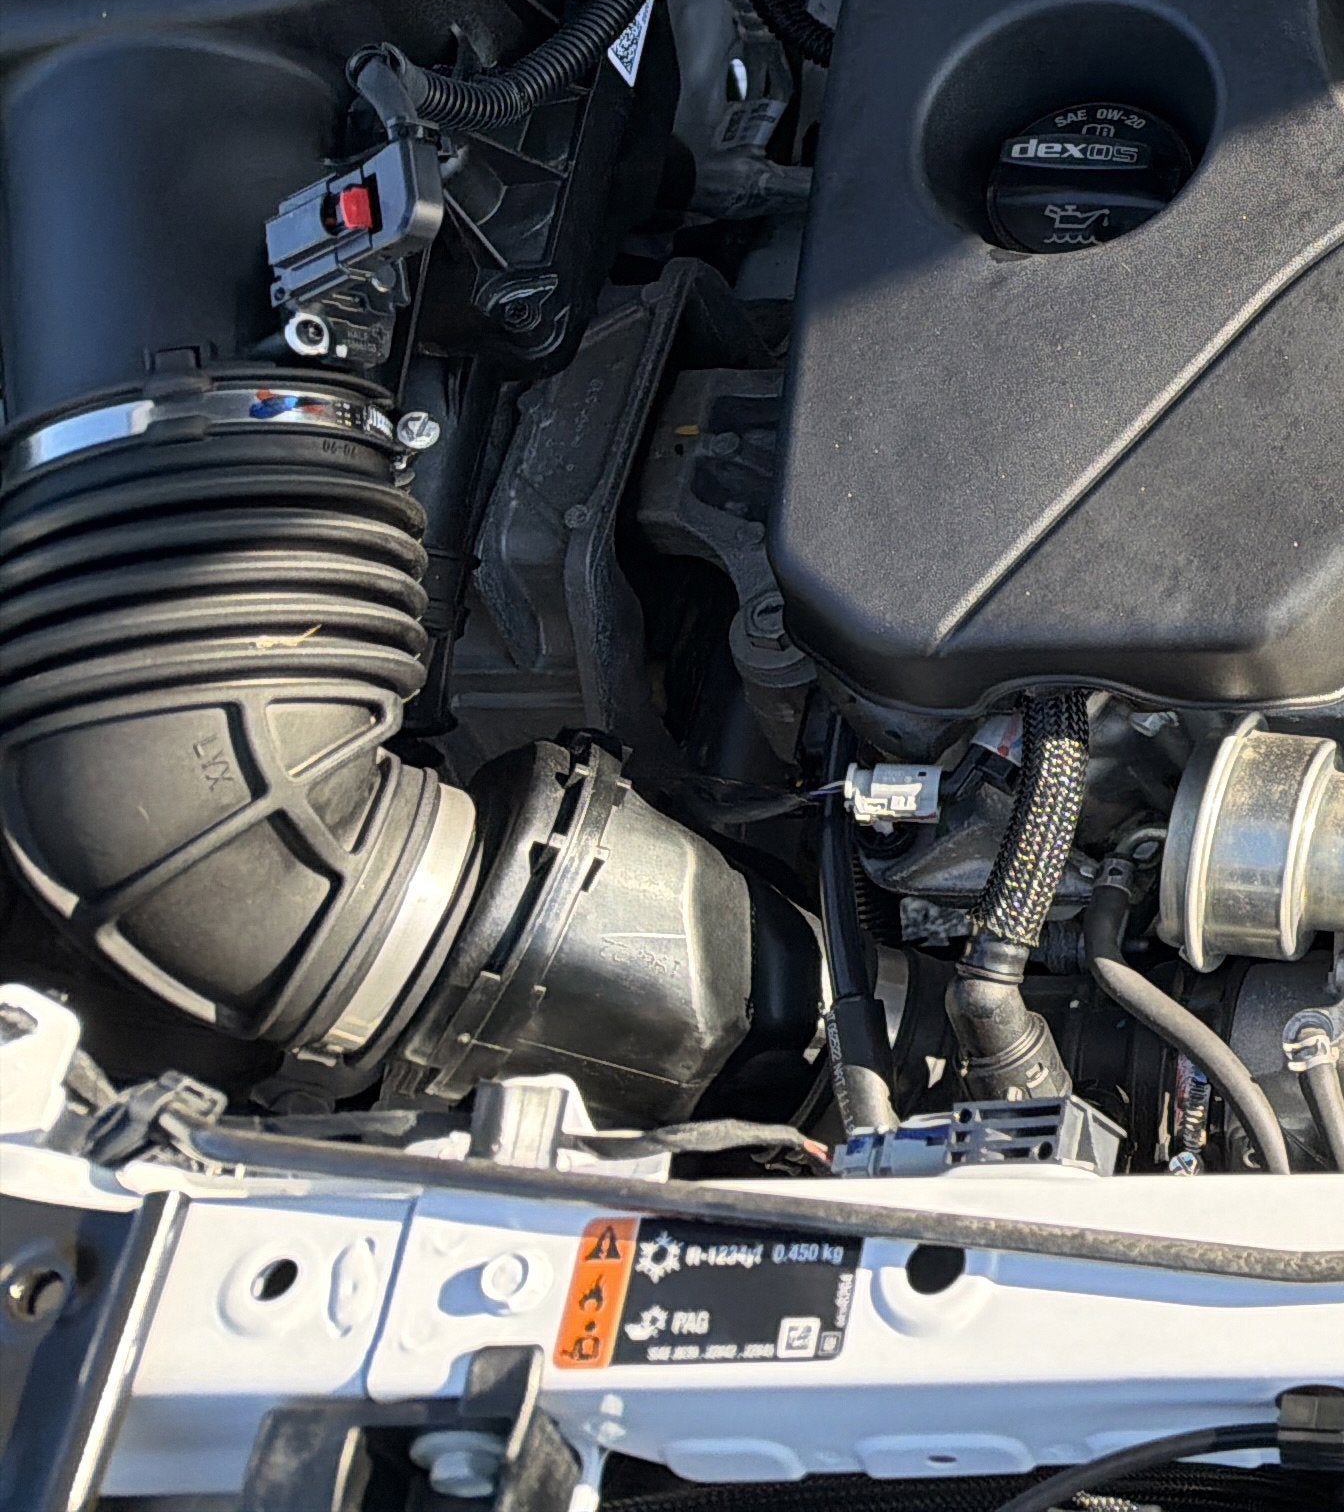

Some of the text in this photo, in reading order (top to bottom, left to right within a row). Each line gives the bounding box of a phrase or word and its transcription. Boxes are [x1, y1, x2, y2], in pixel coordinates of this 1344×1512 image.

[1054, 108, 1147, 130] SAE 0W-20
[1011, 138, 1140, 164] dexos
[772, 1242, 819, 1264] 0.450
[821, 1243, 845, 1265] kg
[671, 1308, 711, 1335] PAG
